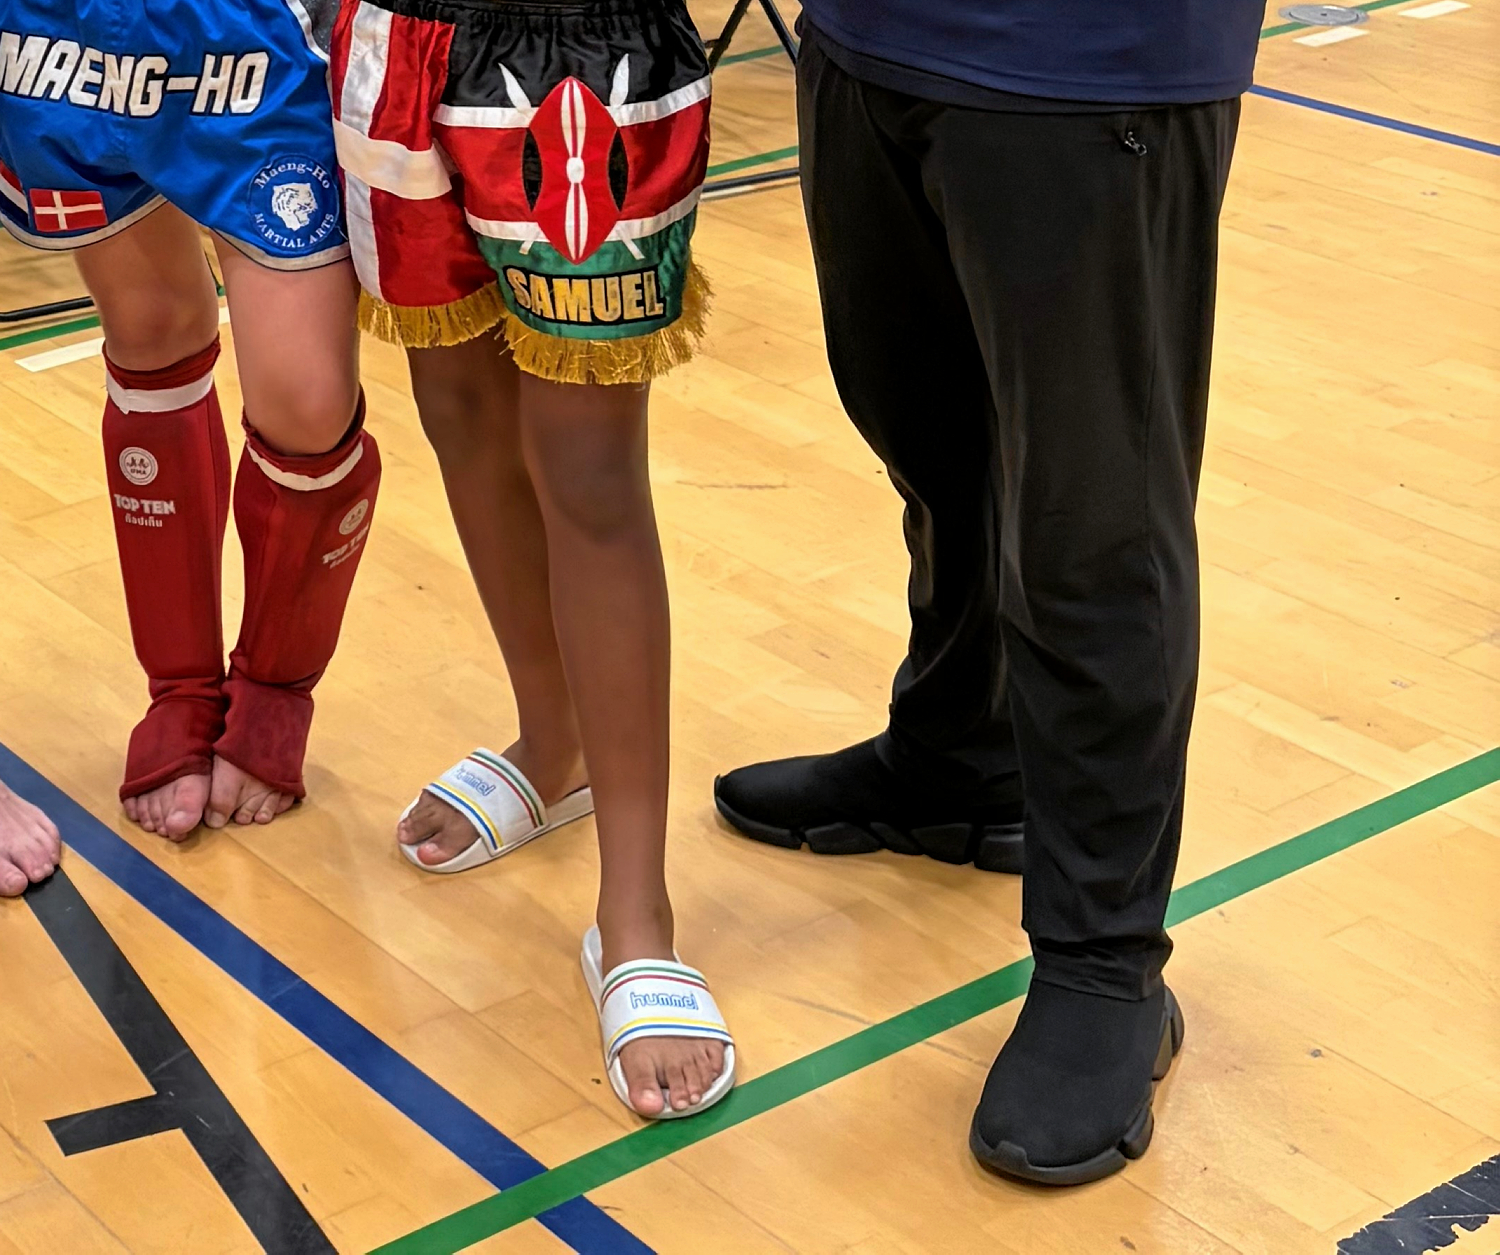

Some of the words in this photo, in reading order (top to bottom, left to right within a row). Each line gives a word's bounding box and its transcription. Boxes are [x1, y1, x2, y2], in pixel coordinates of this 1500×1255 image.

[254, 160, 332, 190] Maeng-Ho
[254, 212, 305, 248] MARTIAL
[309, 212, 335, 244] ARTS
[503, 268, 665, 322] SAMUEL
[114, 493, 140, 512] TOP
[140, 499, 176, 515] TEN
[630, 990, 700, 1011] hummel
